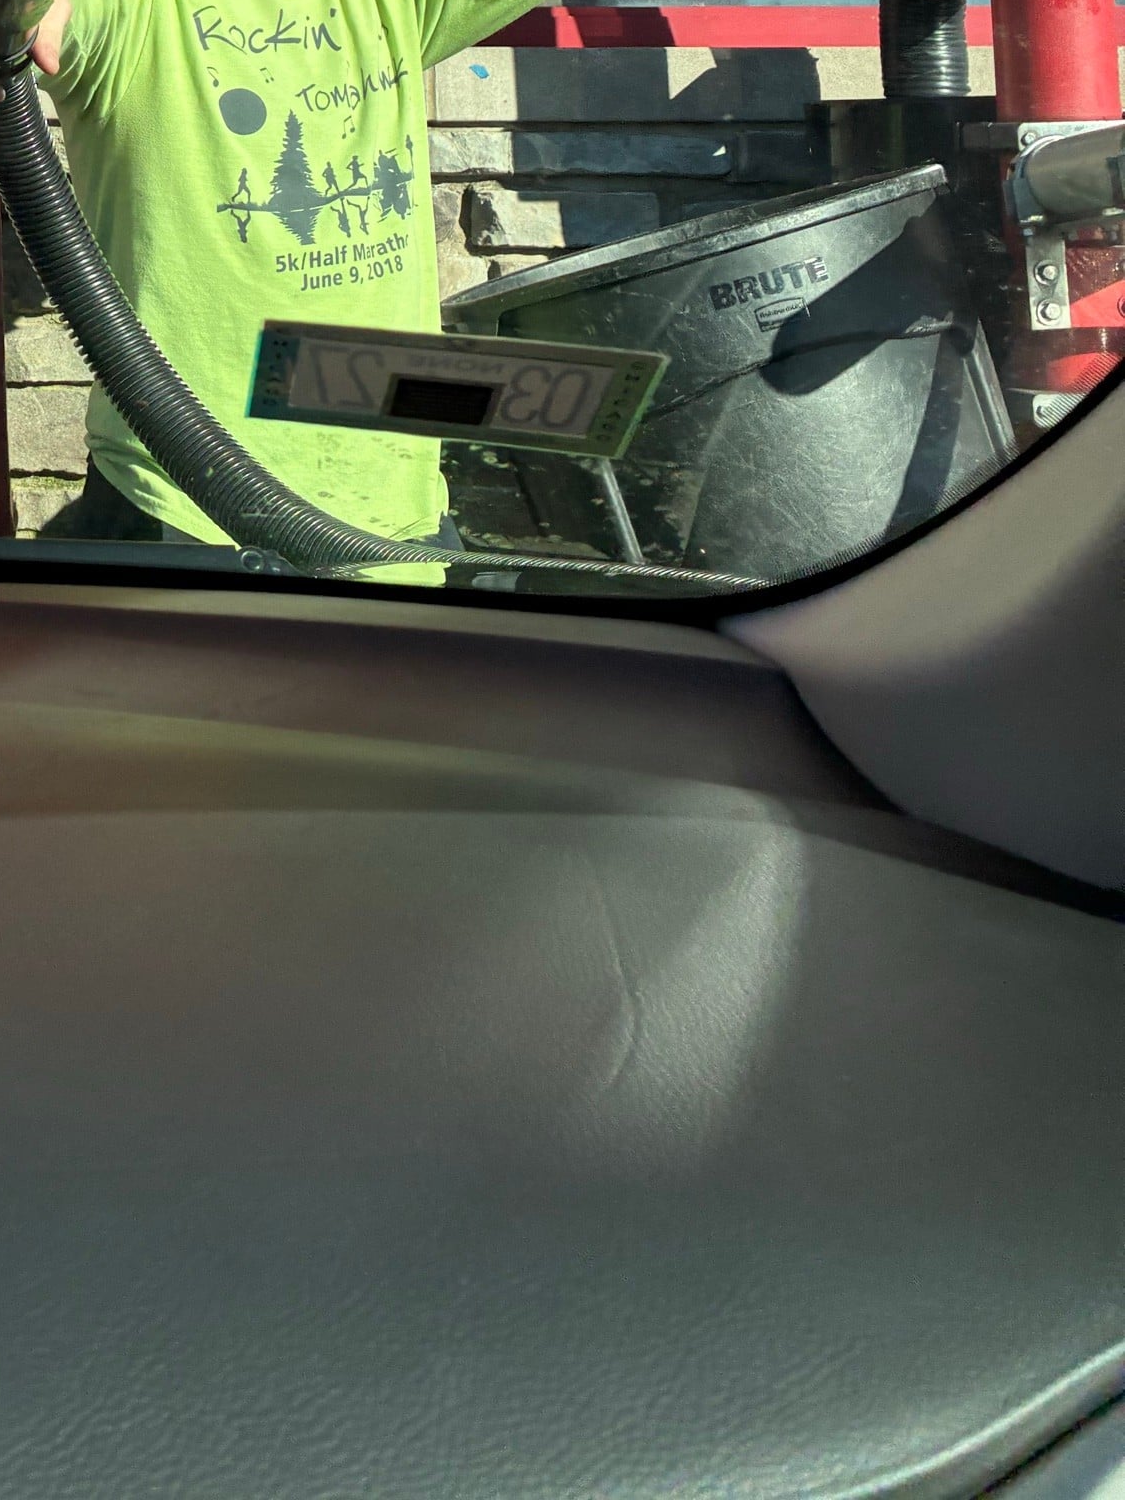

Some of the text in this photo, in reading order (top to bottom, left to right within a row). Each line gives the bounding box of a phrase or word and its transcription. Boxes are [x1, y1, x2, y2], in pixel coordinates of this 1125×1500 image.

[275, 245, 347, 273] 5k/Half
[300, 272, 343, 291] June
[709, 256, 829, 310] BRUTE
